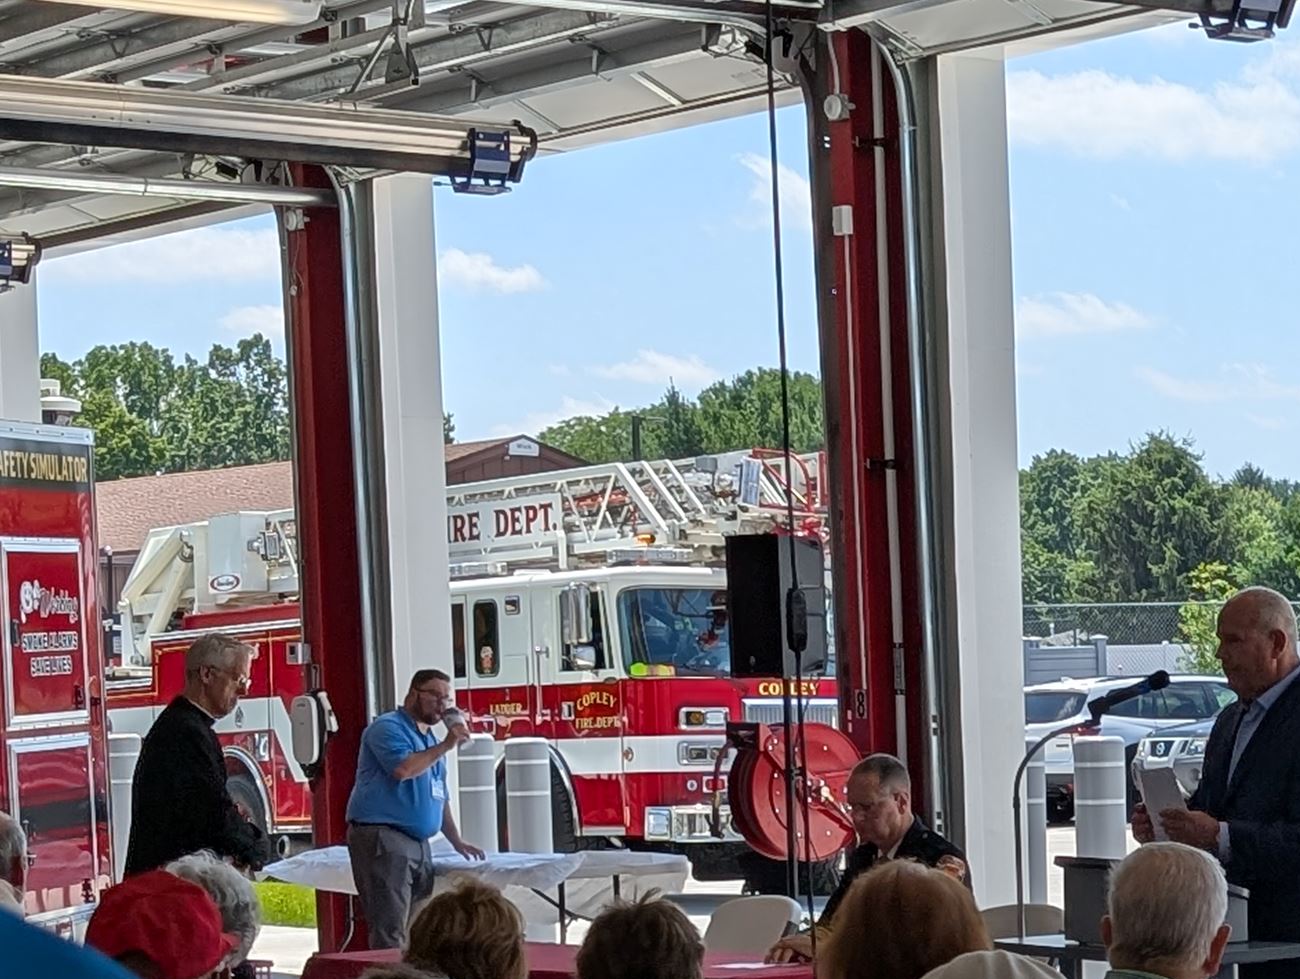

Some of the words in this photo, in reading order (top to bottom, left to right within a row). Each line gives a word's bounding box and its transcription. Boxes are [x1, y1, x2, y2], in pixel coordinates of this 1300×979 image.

[30, 452, 88, 482] SIMULATOR
[493, 502, 557, 538] DEPT.
[576, 691, 617, 711] COPLEY
[856, 691, 865, 717] 8
[575, 717, 594, 729] FIRE
